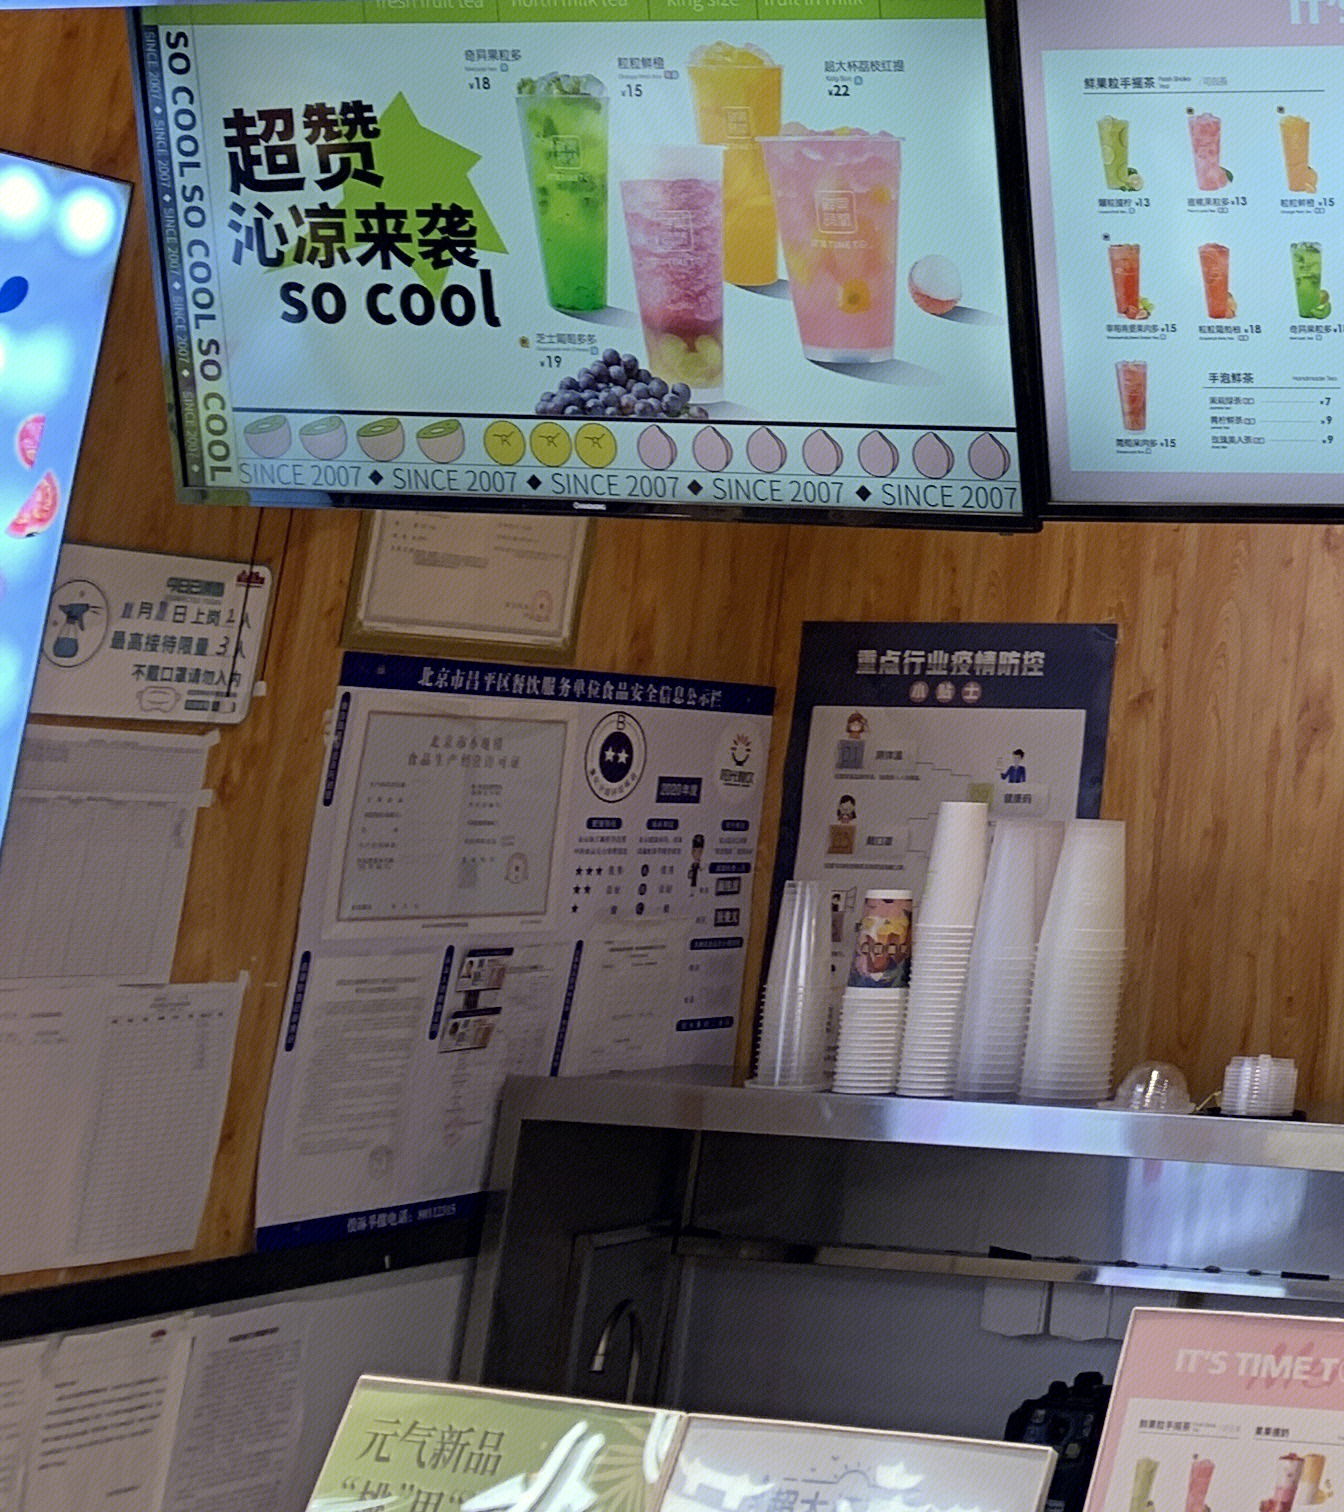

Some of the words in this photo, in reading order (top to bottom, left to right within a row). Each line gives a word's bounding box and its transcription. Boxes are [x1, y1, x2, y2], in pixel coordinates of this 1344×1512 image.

[165, 30, 191, 76] SO
[827, 84, 851, 97] ¥22
[171, 85, 201, 178] COOL
[222, 99, 385, 196] 超赞
[180, 184, 206, 230] SO
[226, 201, 480, 271] 沁凉来袭
[186, 238, 217, 331] COOL
[196, 338, 223, 383] SO
[1208, 372, 1255, 384] 手泡鲜茶
[202, 391, 234, 482] COOL
[239, 463, 303, 487] SINCE
[310, 464, 362, 488] 2007
[393, 468, 459, 491] SINCE
[466, 469, 518, 493] 2007
[551, 472, 619, 497] SINCE
[625, 475, 680, 499] 2007
[712, 477, 783, 503] SINCE
[790, 480, 844, 505] 2007
[881, 483, 954, 509] SINCE
[960, 485, 1020, 510] 2007
[855, 648, 1046, 677] 重点行业疫情防控
[1174, 1347, 1230, 1375] IT'S
[1235, 1351, 1312, 1382] TIME
[355, 1419, 506, 1477] 元气新品
